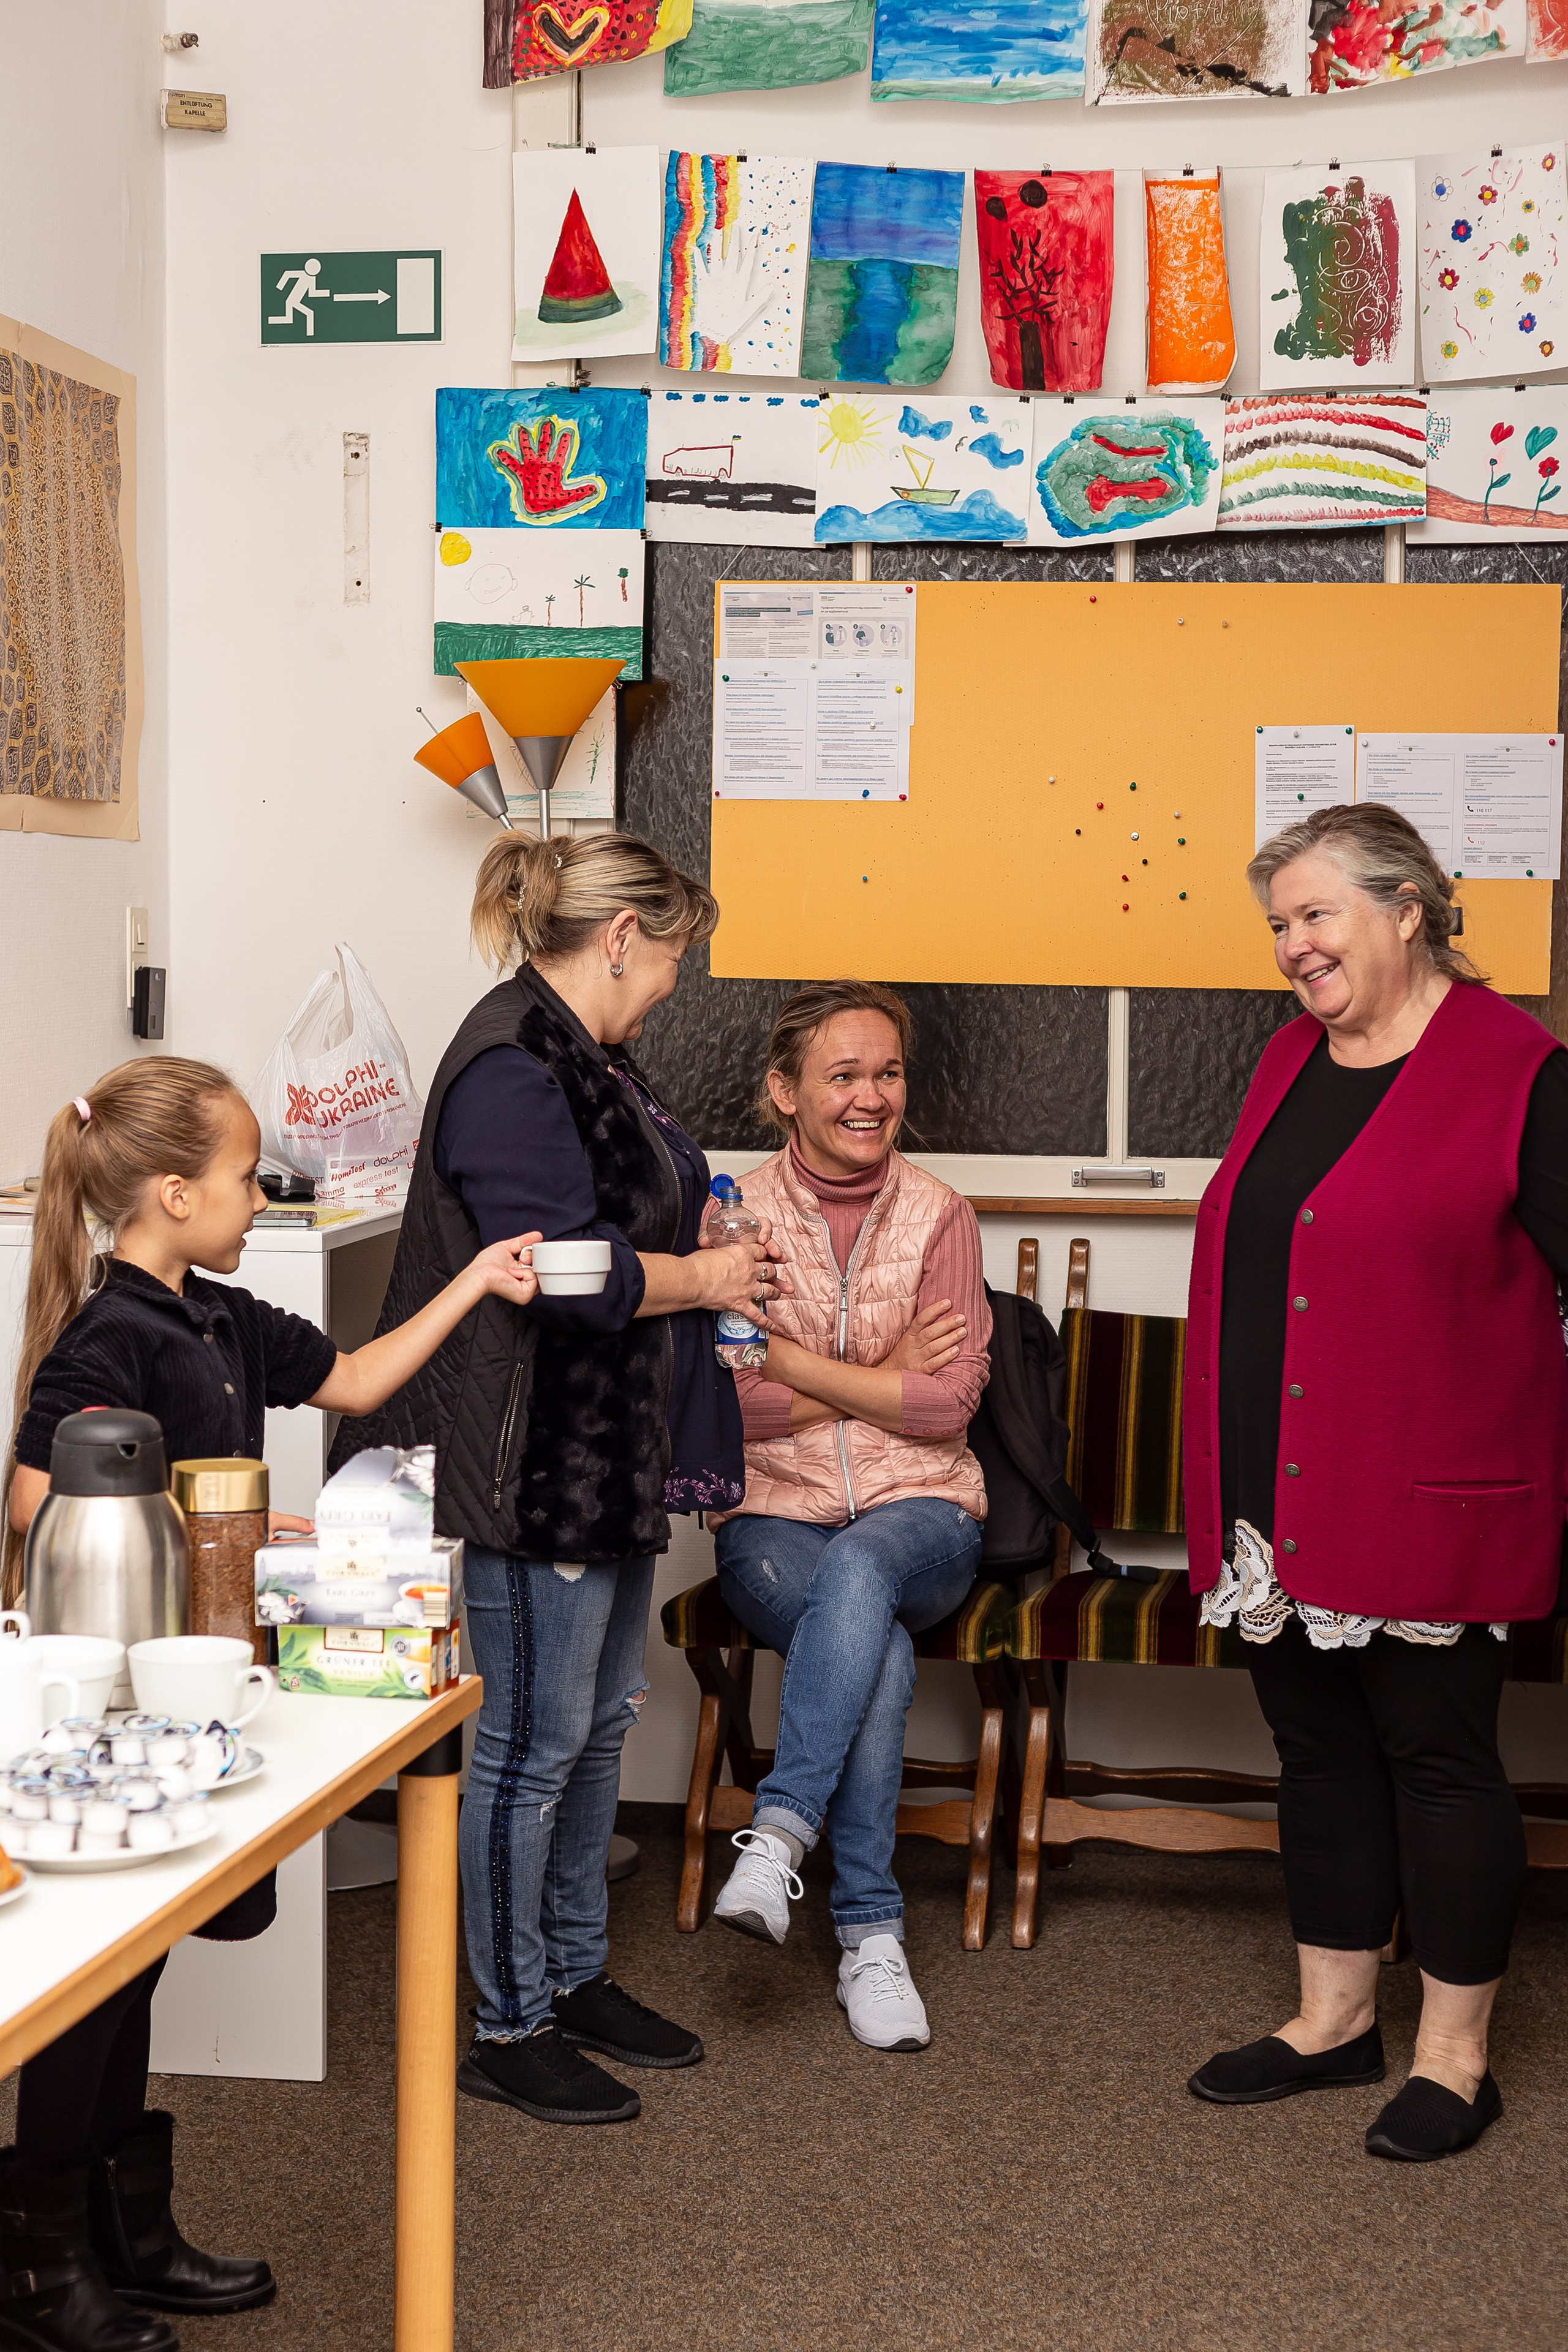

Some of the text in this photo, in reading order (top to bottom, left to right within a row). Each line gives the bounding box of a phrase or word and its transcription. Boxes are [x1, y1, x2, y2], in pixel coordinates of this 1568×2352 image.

[314, 1077, 401, 1128] UKRAINE
[353, 1166, 399, 1188] express test
[372, 1659, 391, 1668] TEE
